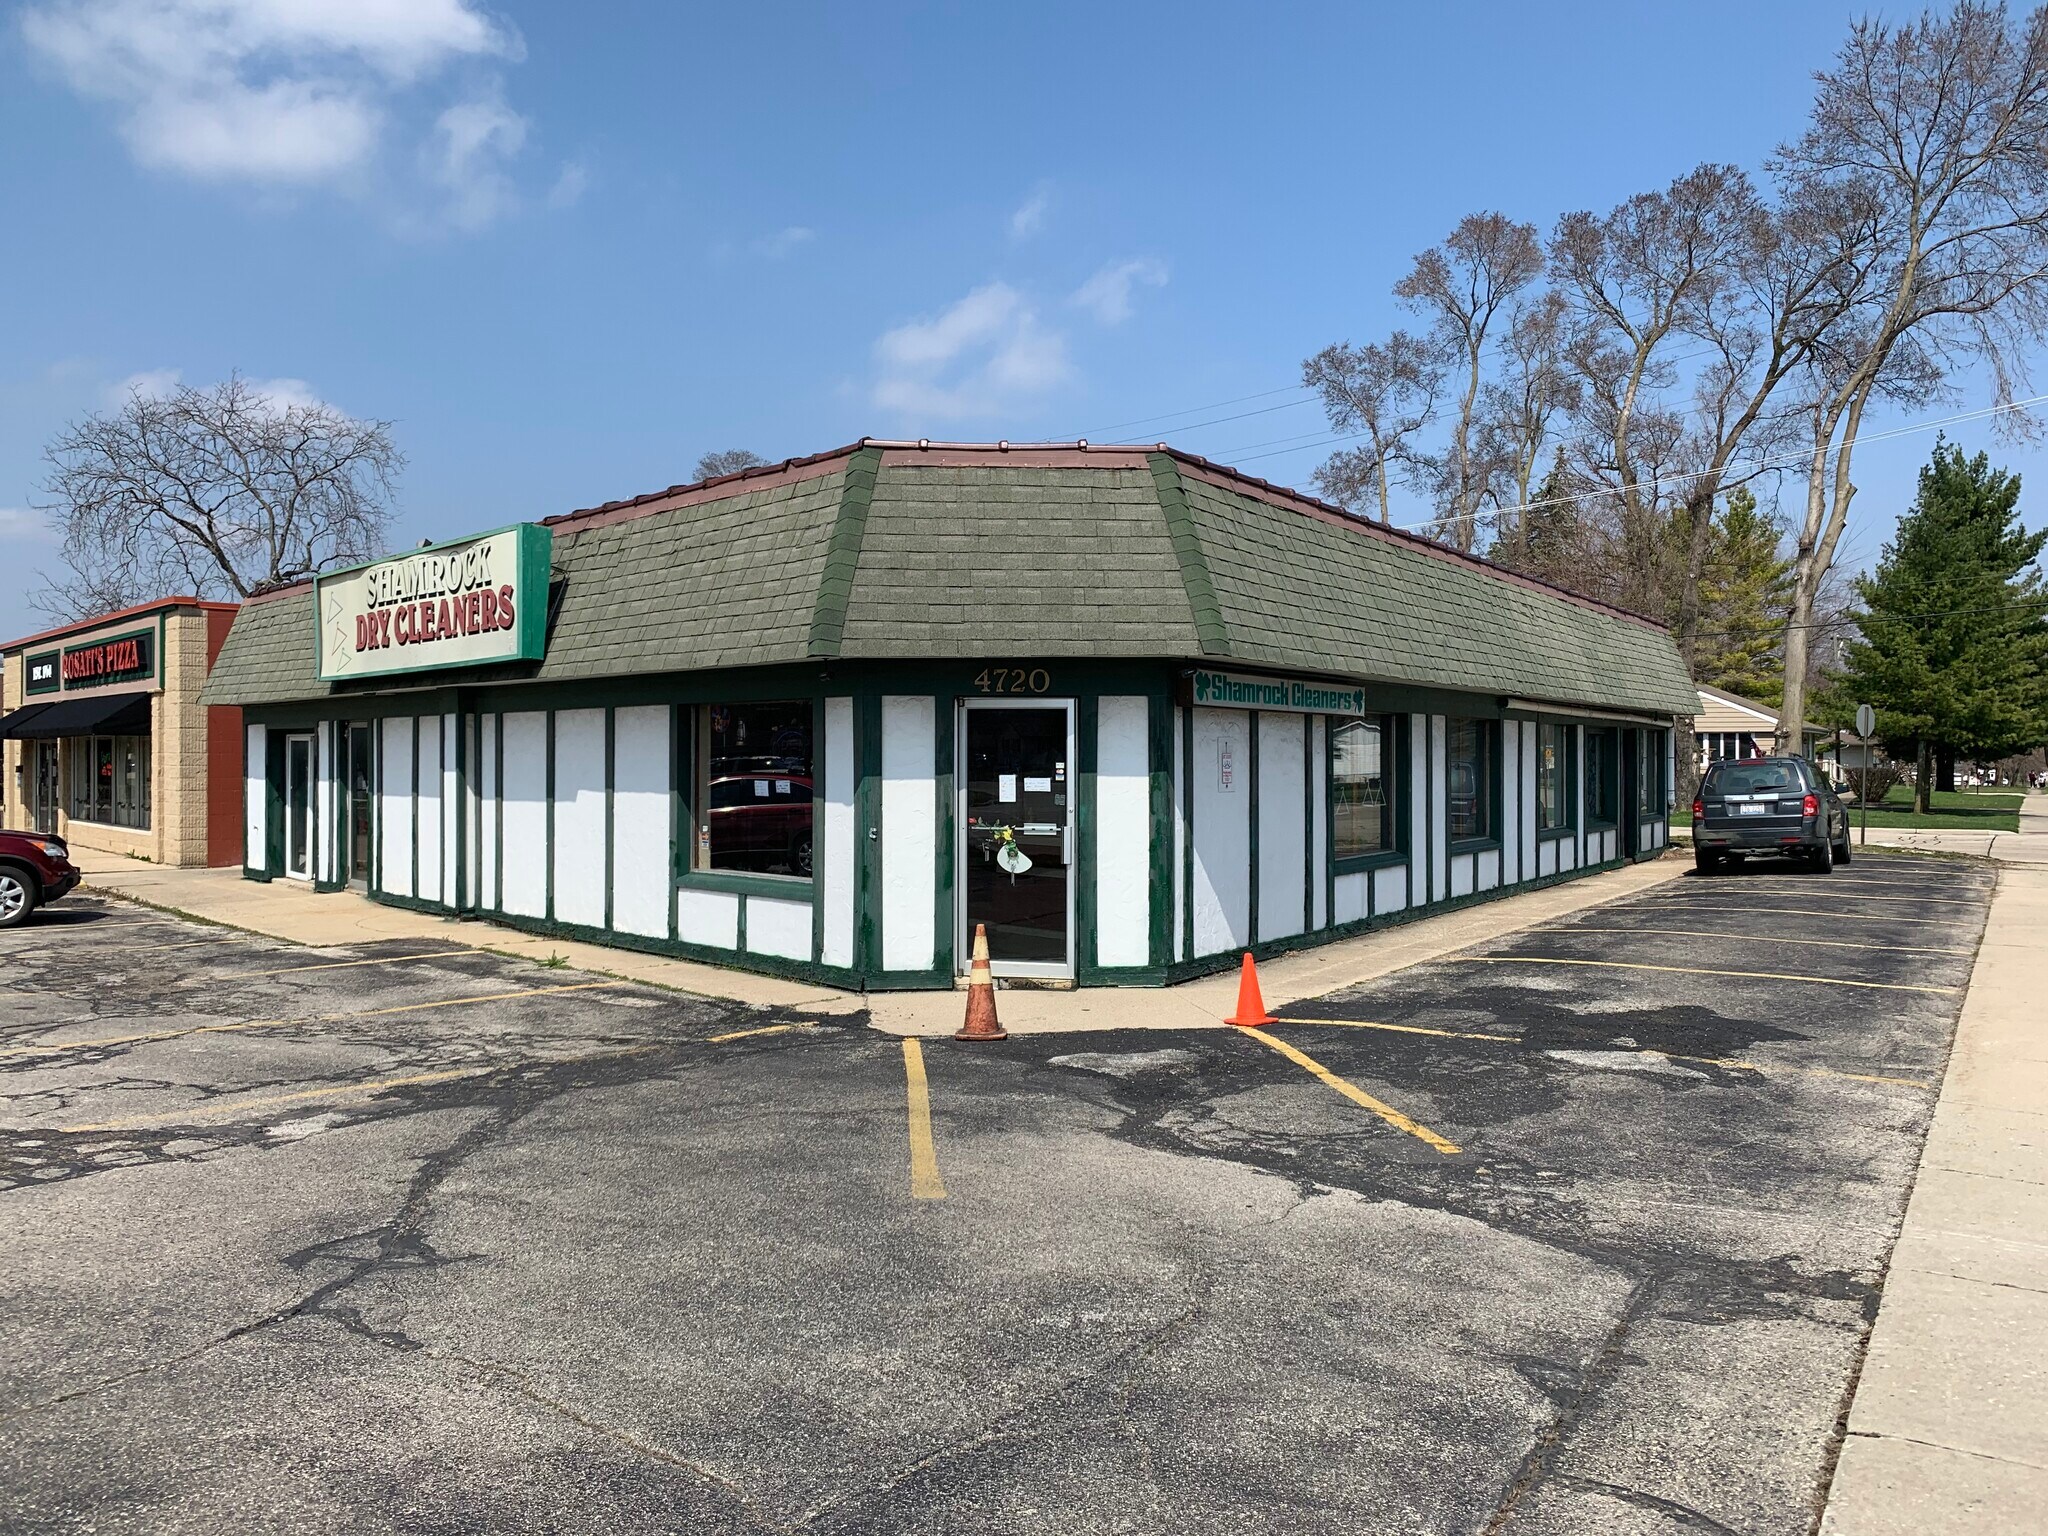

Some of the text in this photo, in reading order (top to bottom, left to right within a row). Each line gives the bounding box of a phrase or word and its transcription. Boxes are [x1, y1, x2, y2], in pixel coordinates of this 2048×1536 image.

[368, 542, 492, 609] SHAMROCK
[355, 584, 514, 652] DRY CLEANERS
[62, 647, 104, 679] ROSATI'S
[106, 640, 139, 672] PIZZA
[974, 669, 1050, 692] 4720
[1211, 674, 1351, 709] Shamrock Cleaners
